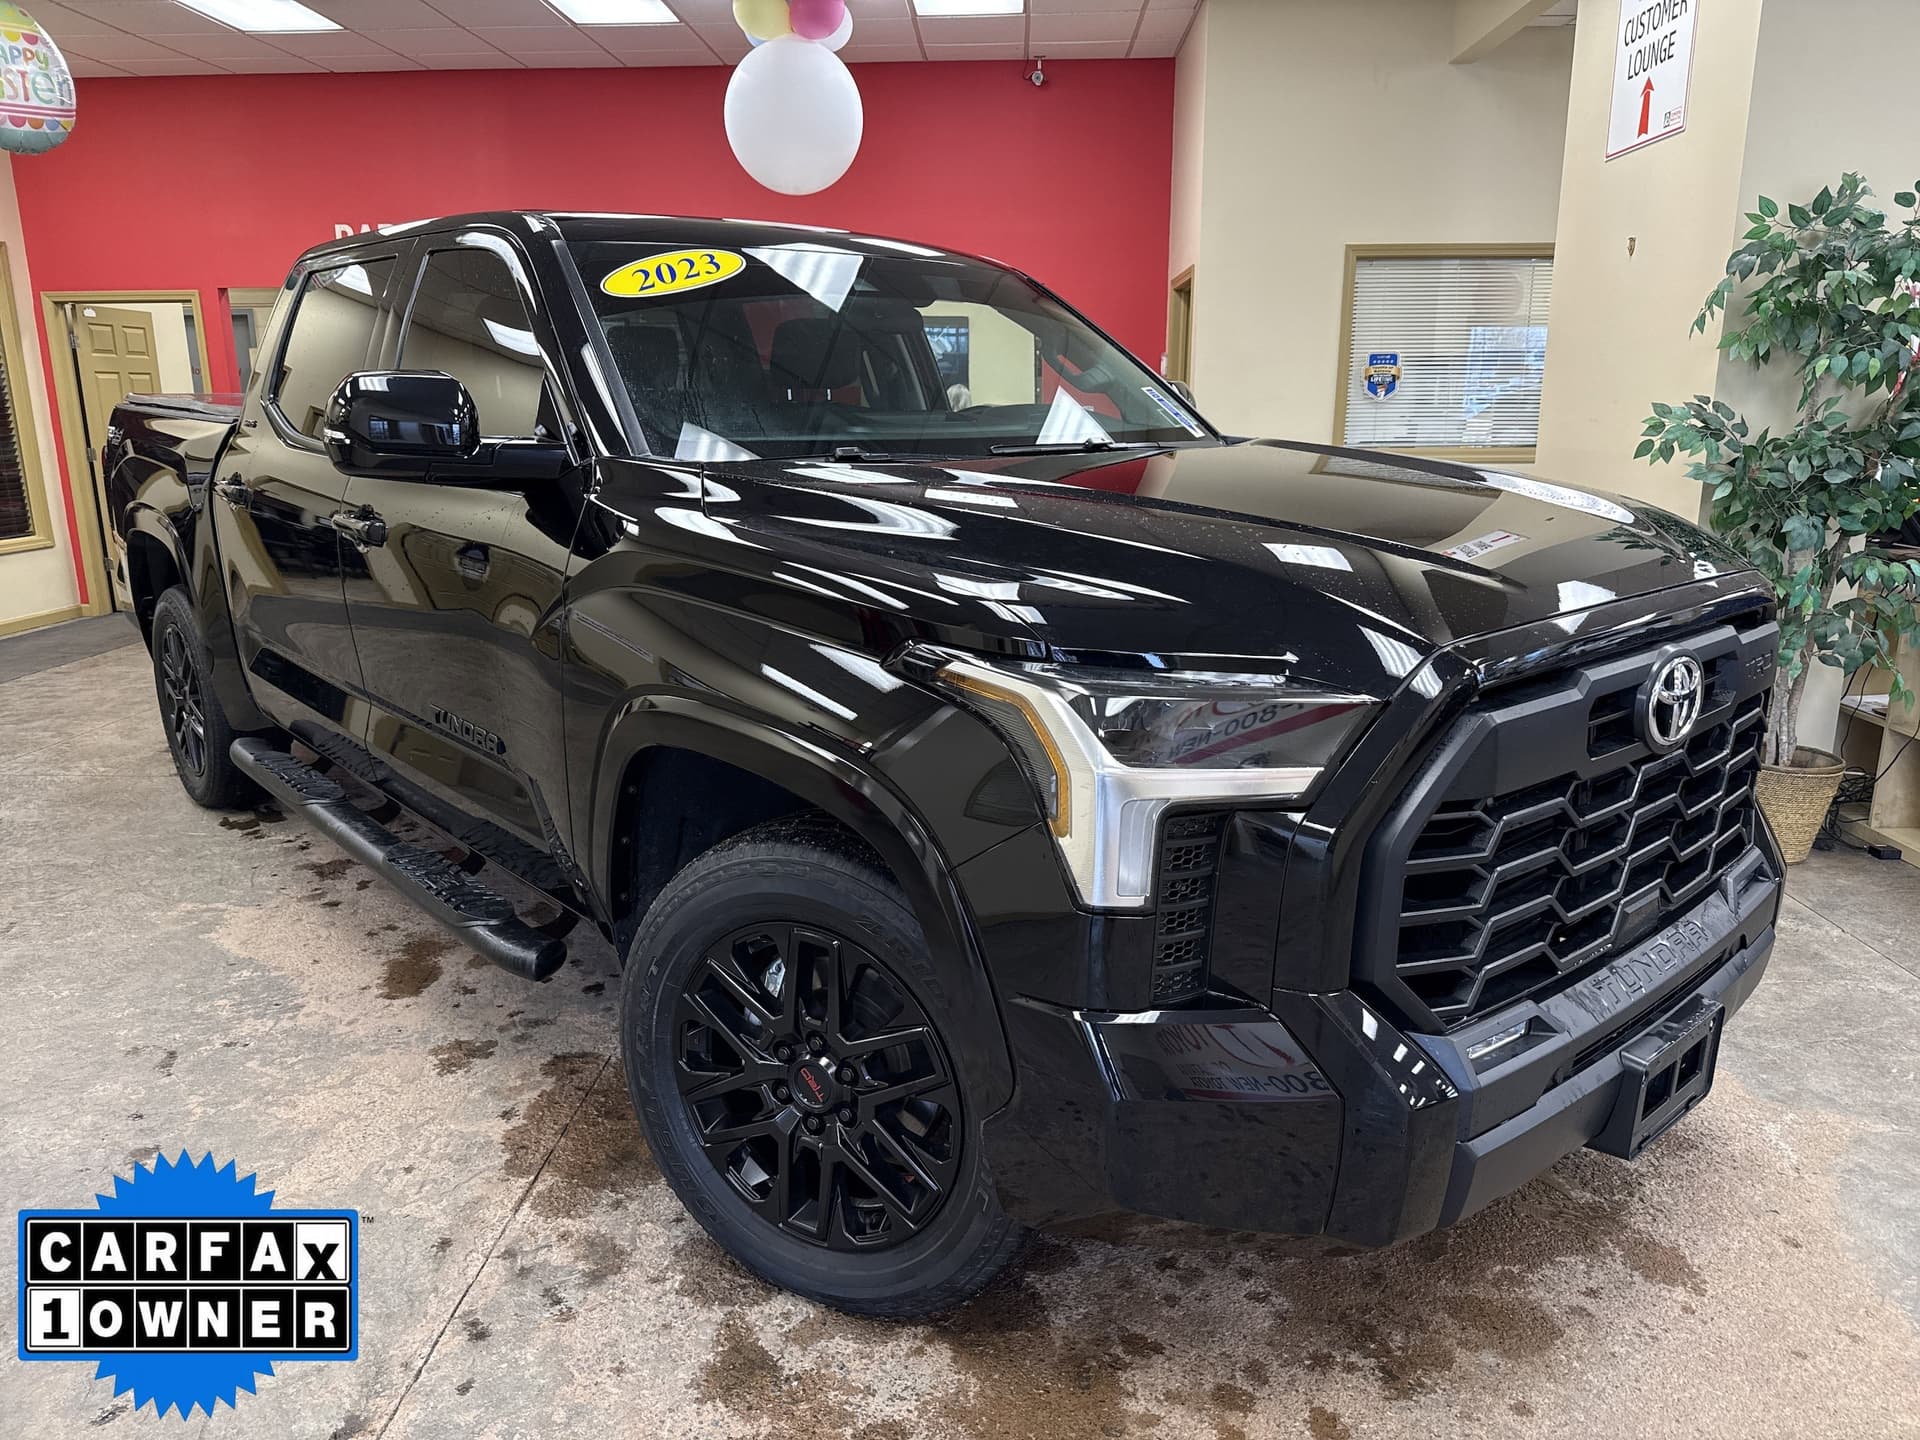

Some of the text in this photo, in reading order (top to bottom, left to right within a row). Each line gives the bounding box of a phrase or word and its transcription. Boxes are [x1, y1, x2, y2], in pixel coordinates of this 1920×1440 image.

[1627, 30, 1677, 80] LOUNGE
[632, 253, 721, 292] 2023
[430, 703, 506, 755] TUNDRA
[1592, 919, 1713, 1007] TUNDRA
